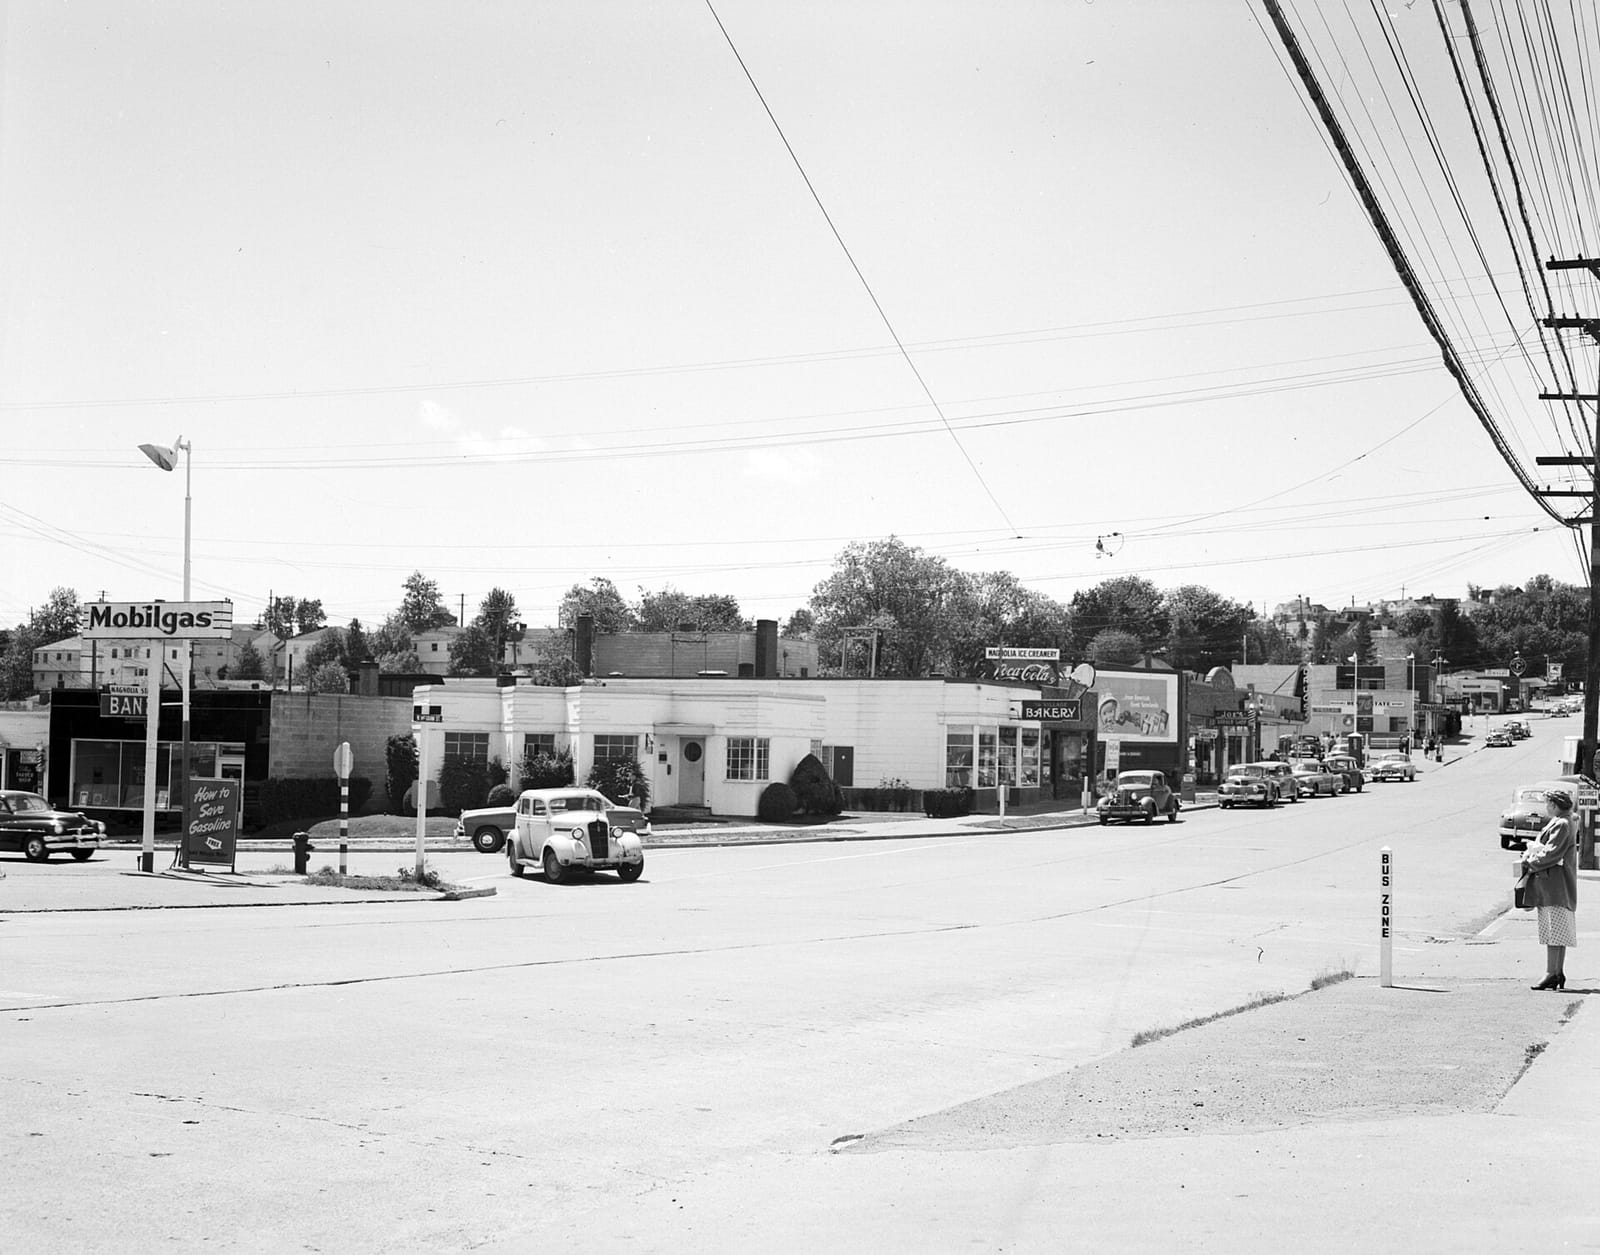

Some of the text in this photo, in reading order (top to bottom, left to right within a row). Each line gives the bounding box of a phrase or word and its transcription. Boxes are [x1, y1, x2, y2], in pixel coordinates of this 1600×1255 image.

[90, 605, 213, 634] Mobilgas
[993, 663, 1050, 681] Coca-Cola
[110, 696, 148, 715] BAN
[1026, 706, 1076, 718] BAKERY
[194, 786, 230, 803] How to
[199, 803, 224, 818] Save
[189, 818, 232, 835] Gasoline
[1382, 853, 1390, 938] BUS ZONE
